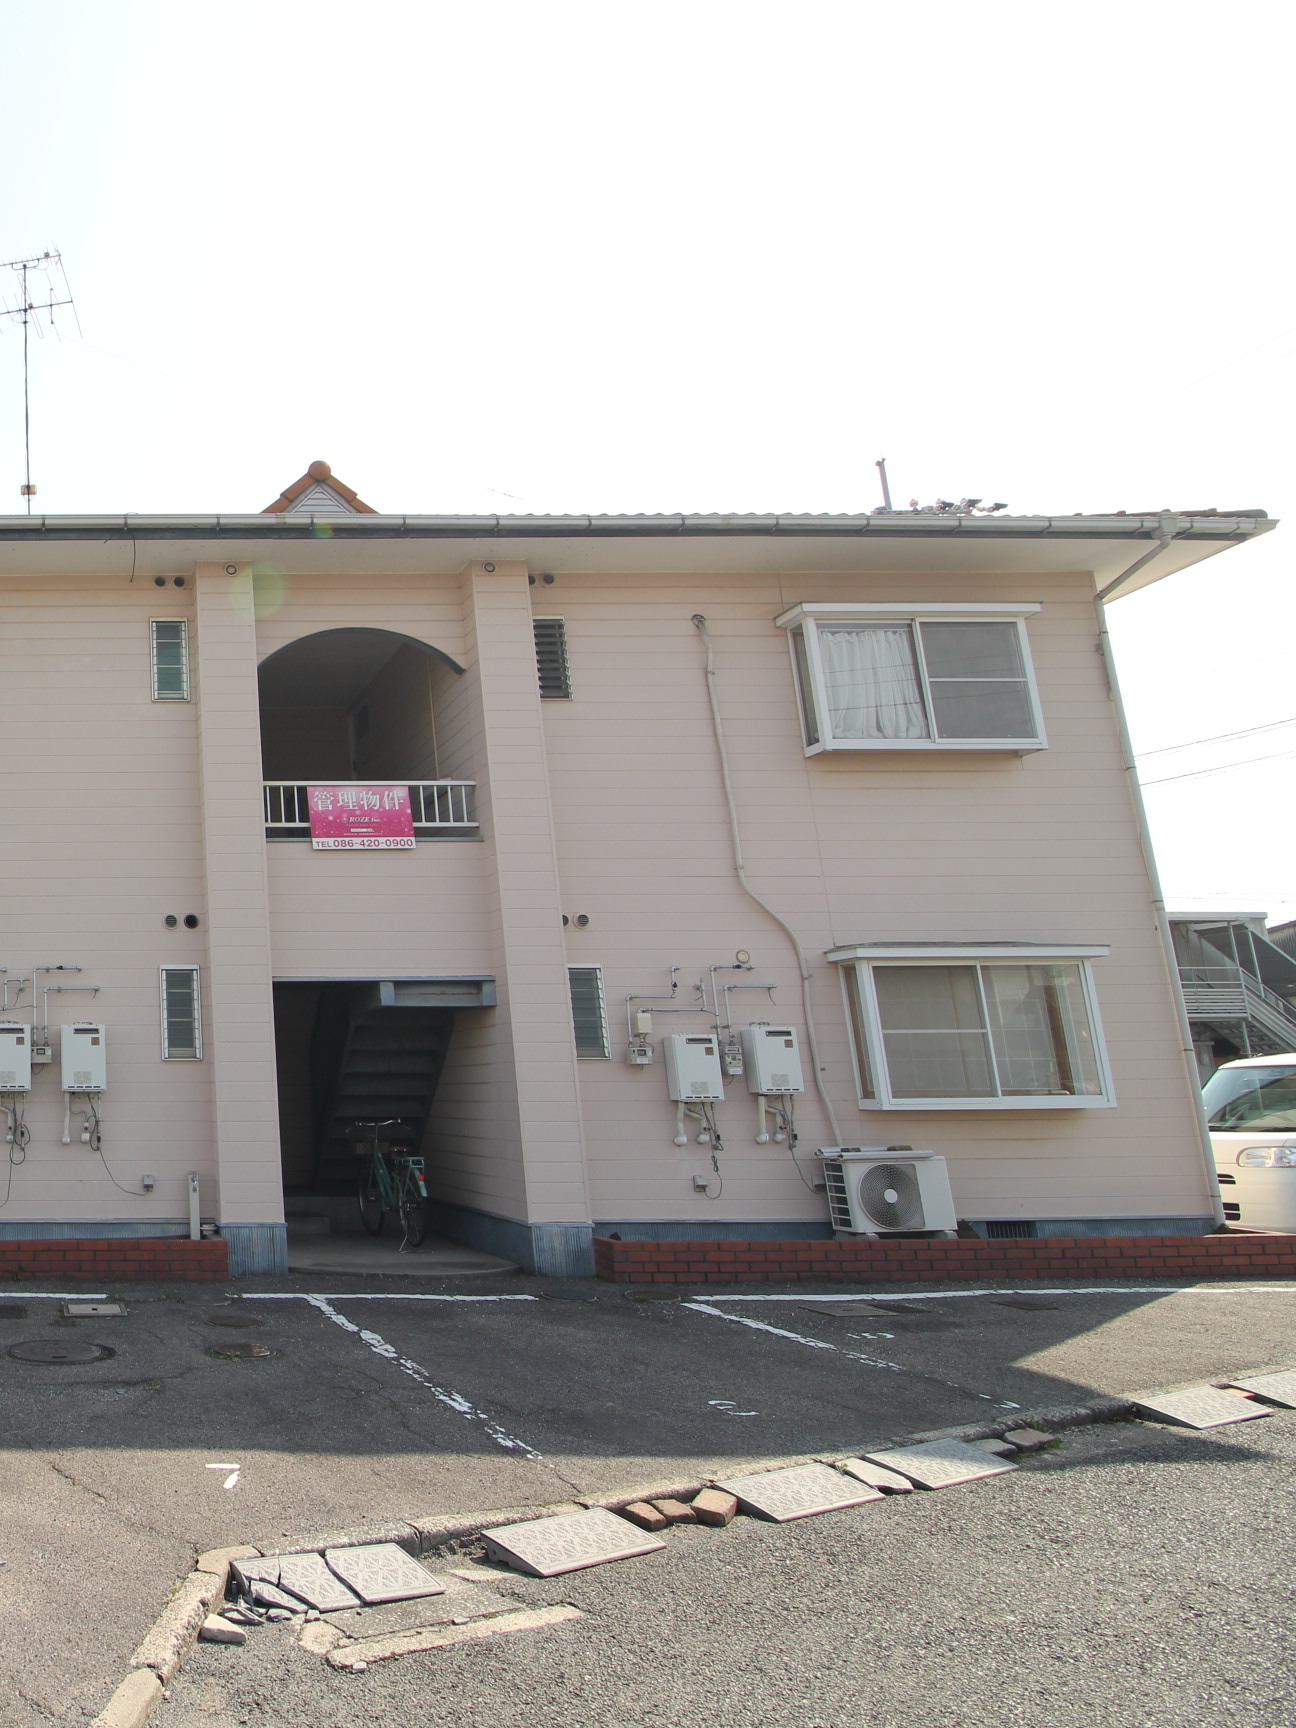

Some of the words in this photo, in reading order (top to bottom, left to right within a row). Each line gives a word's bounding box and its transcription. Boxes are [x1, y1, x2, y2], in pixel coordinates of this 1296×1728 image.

[313, 790, 404, 811] 管理物件
[333, 839, 413, 847] 086-420-0900
[204, 1463, 241, 1490] 7
